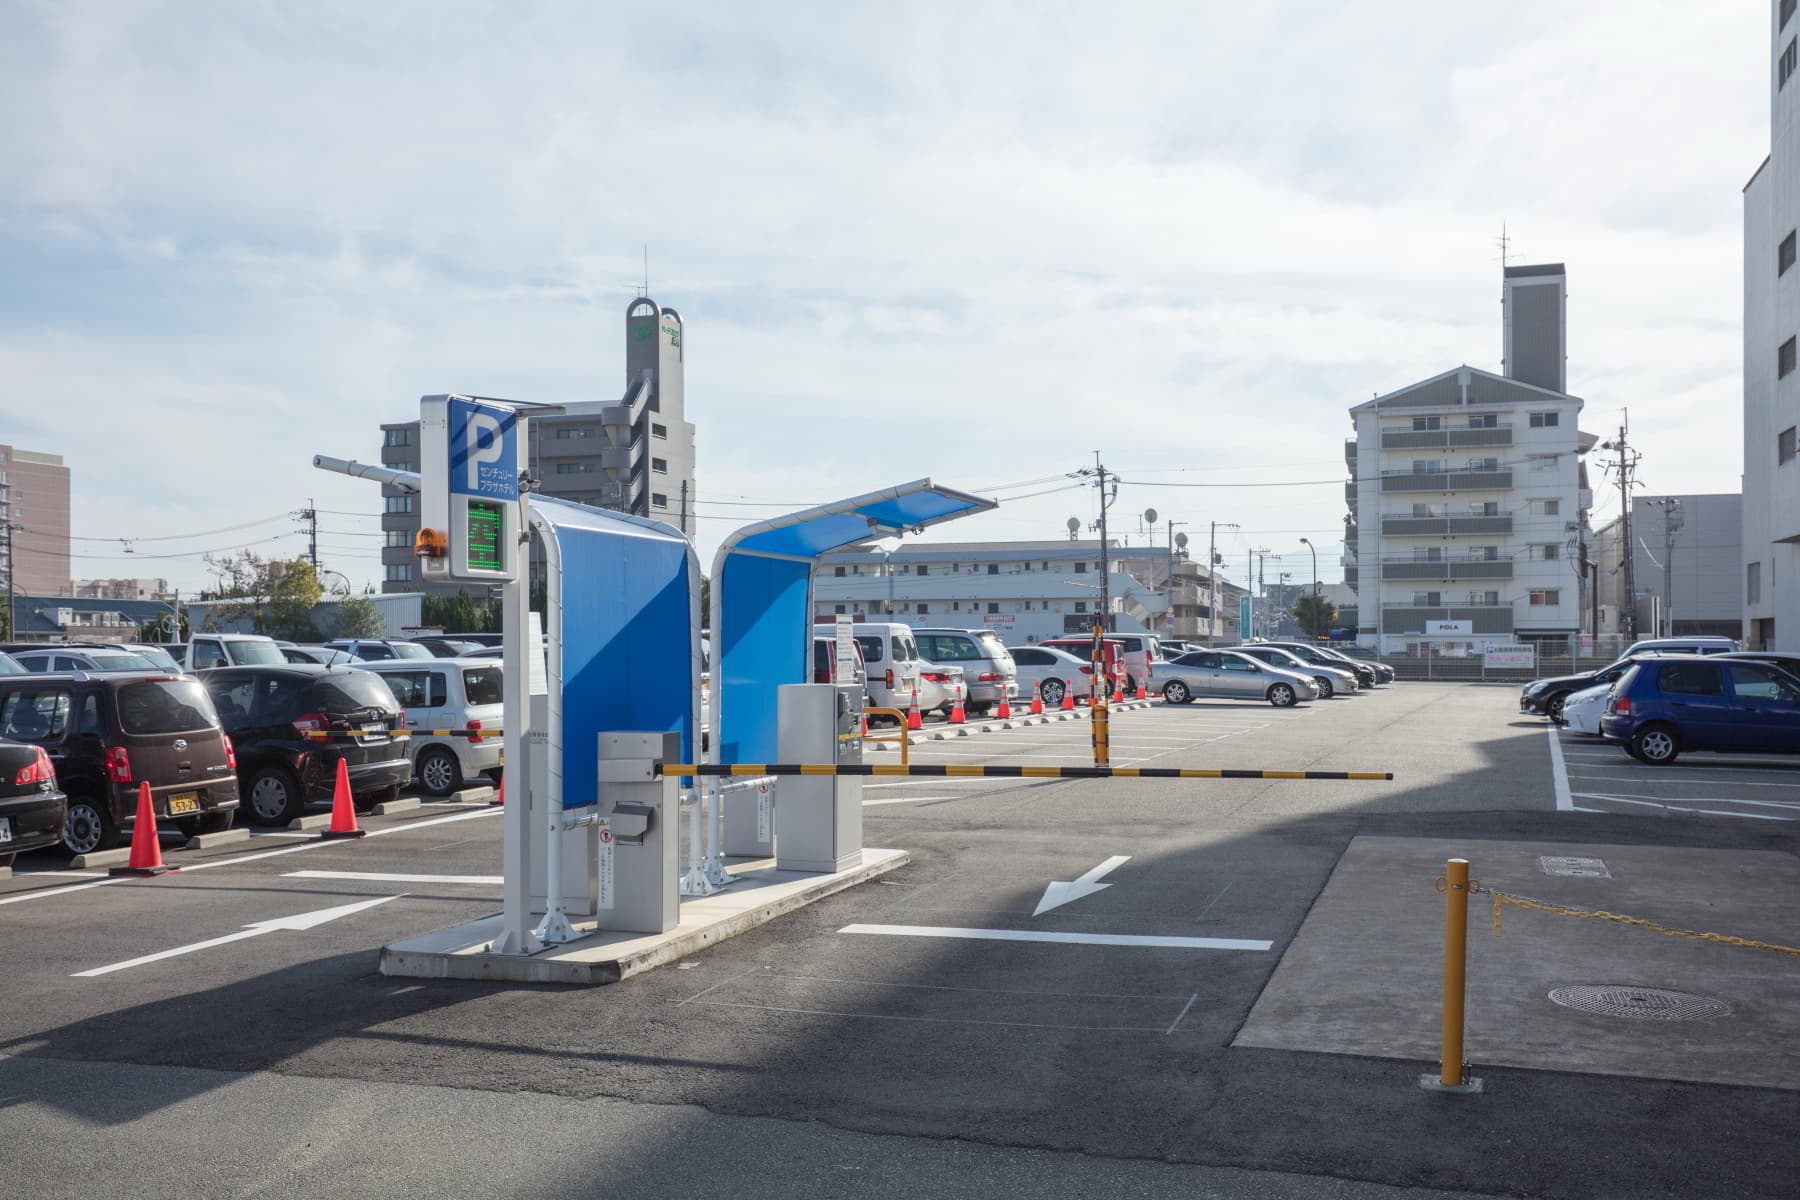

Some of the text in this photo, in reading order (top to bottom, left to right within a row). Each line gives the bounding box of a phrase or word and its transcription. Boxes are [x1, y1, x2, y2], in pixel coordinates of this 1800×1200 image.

[466, 411, 503, 490] P
[480, 466, 513, 480] センチュリー
[467, 503, 501, 569] 空
